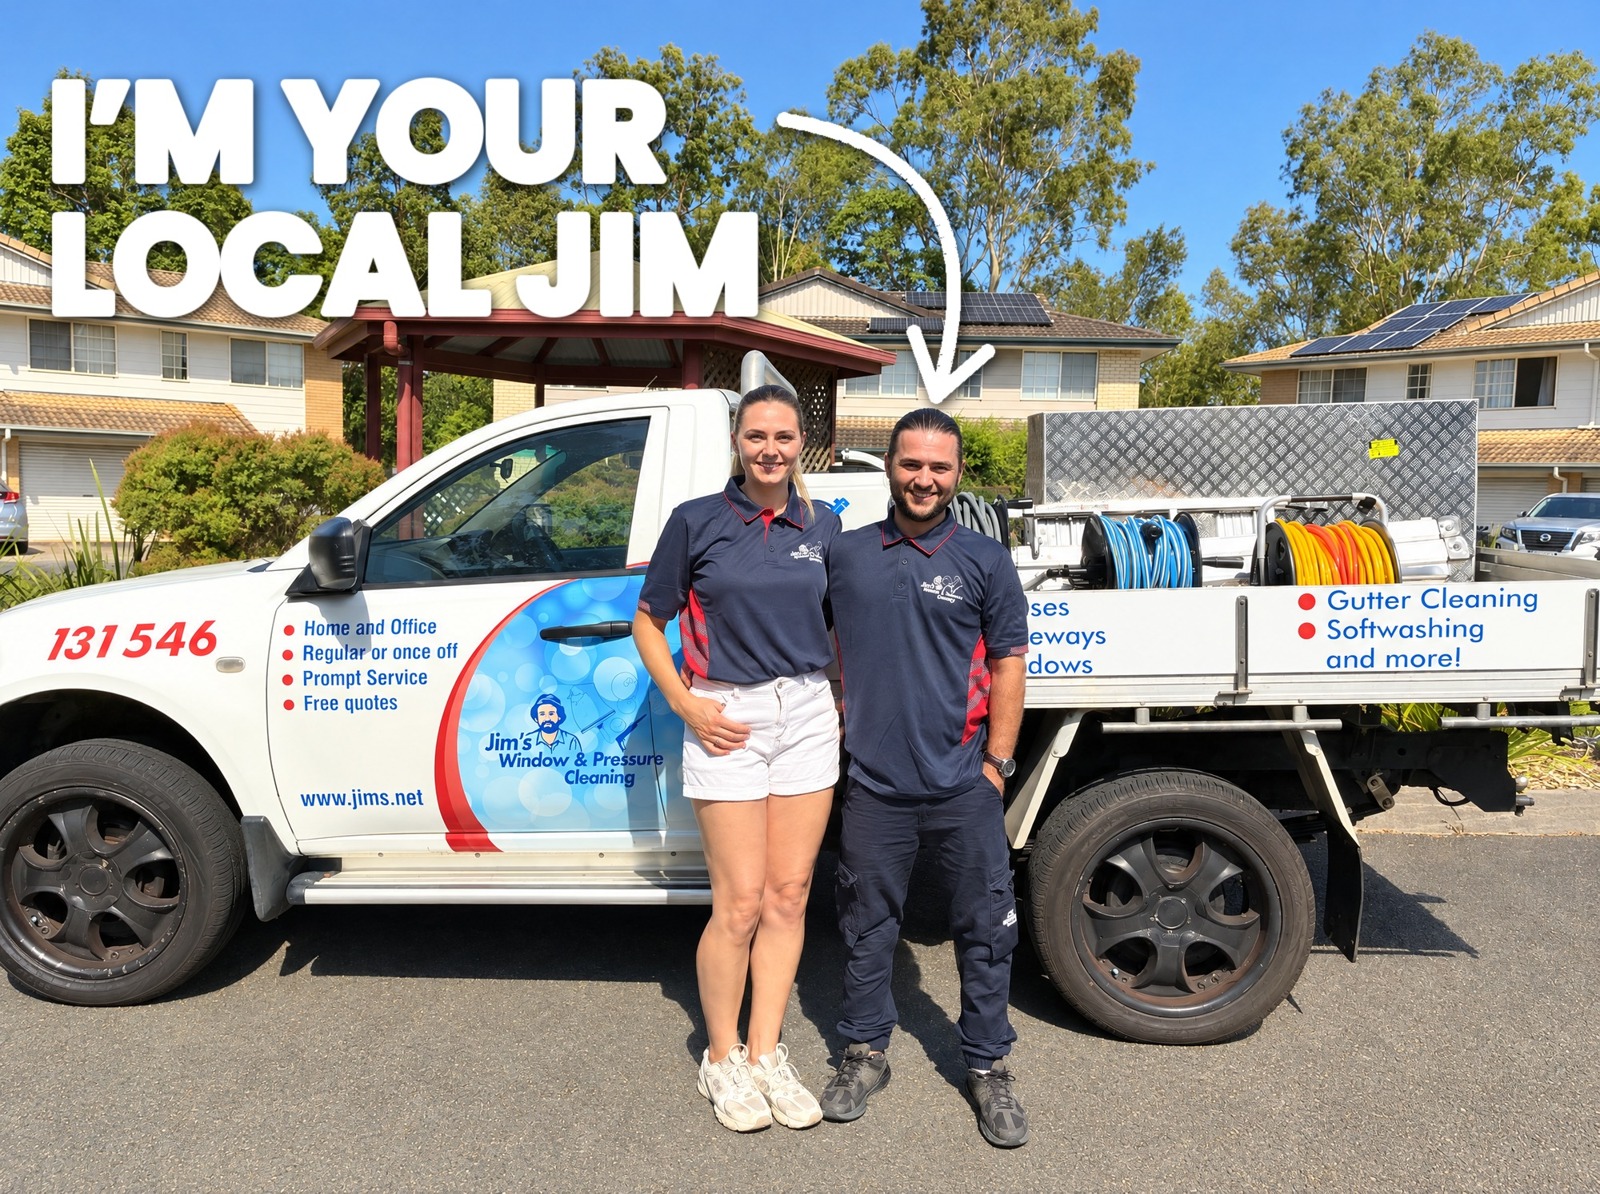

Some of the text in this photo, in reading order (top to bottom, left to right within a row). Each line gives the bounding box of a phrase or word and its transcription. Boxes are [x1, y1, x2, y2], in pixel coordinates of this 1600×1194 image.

[1031, 602, 1070, 617] ses
[1327, 586, 1538, 613] Gutter Cleaning
[304, 618, 437, 636] Home and Office
[1327, 617, 1484, 643] Softwashing
[47, 619, 217, 661] 131 546
[1029, 630, 1107, 650] eways
[303, 642, 458, 665] Regular or once off
[1028, 653, 1093, 675] dows
[1326, 647, 1461, 669] and more!
[303, 669, 428, 689] Prompt Service
[304, 695, 398, 714] Free quotes
[499, 751, 664, 768] Window & Pressure
[564, 769, 636, 788] Cleaning
[300, 788, 424, 811] www.jims.net
